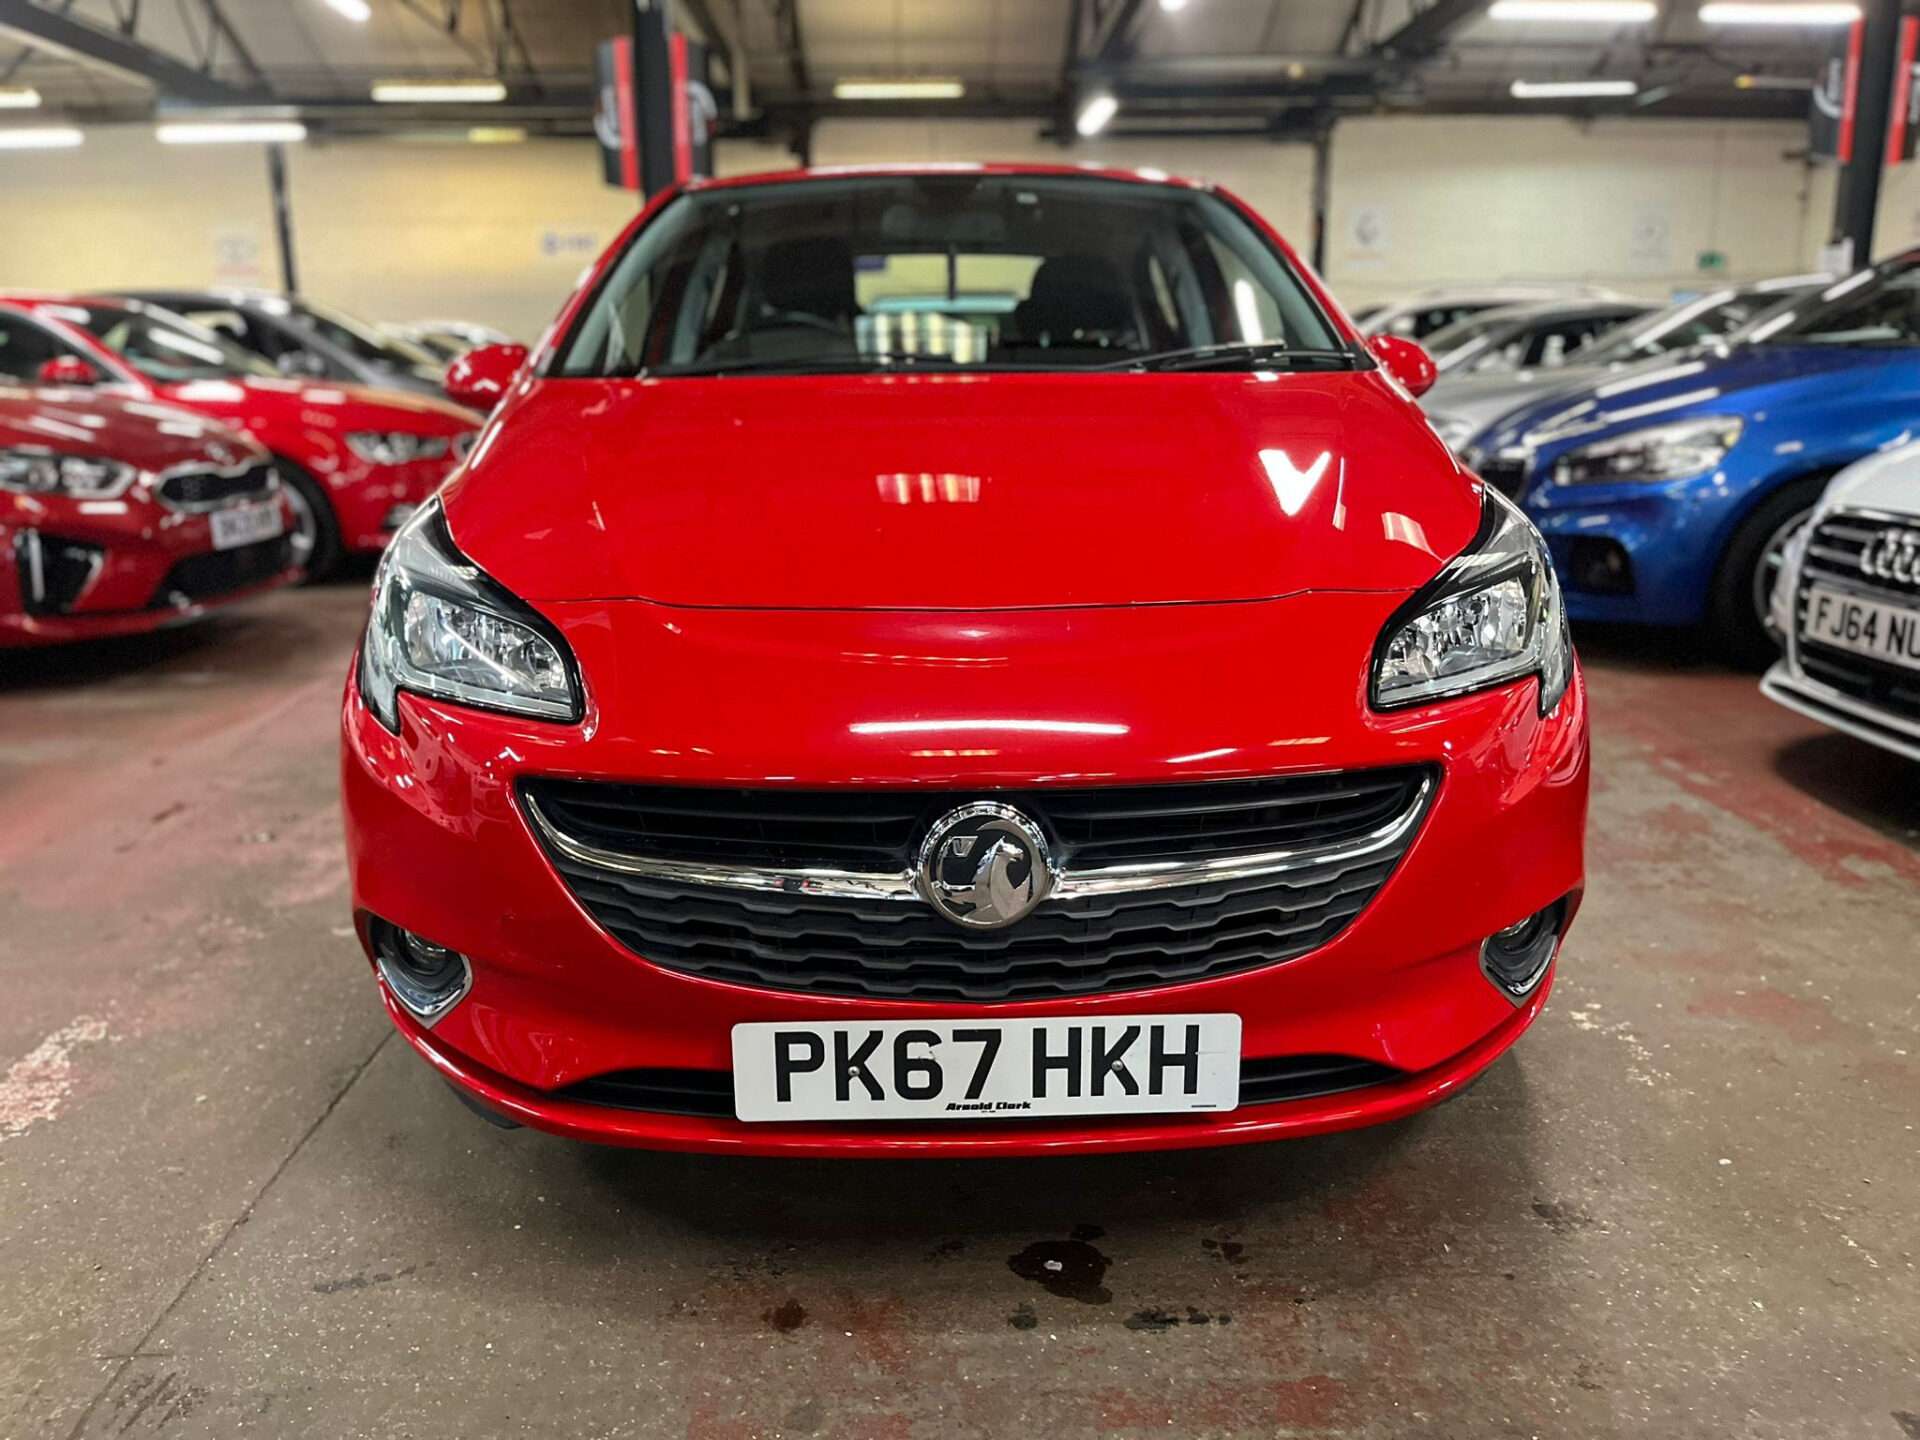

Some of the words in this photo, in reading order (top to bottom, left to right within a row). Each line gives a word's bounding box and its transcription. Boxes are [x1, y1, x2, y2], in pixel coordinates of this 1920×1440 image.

[1814, 596, 1878, 648] FJ64
[774, 1028, 1002, 1102] PK67
[1032, 1024, 1200, 1098] HKH
